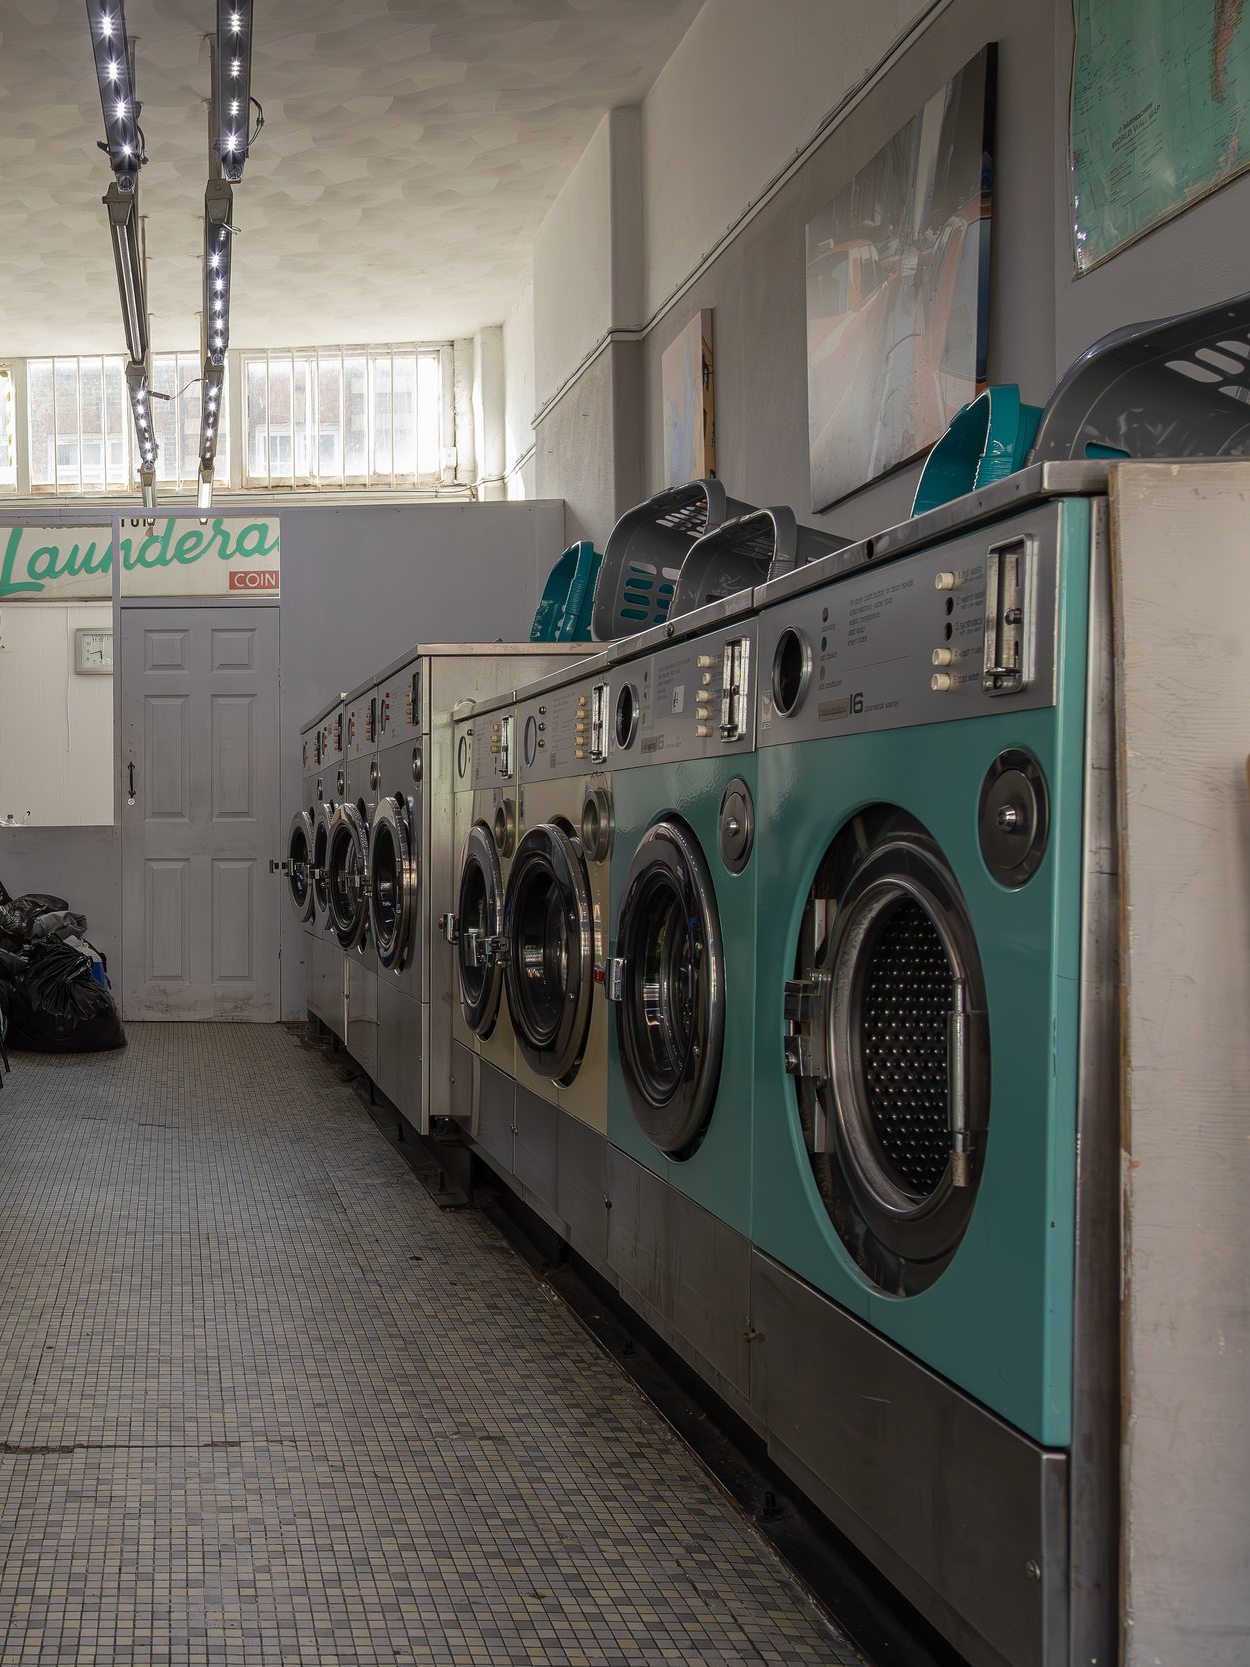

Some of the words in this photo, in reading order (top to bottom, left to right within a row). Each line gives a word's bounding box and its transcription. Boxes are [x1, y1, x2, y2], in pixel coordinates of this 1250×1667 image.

[1111, 128, 1132, 149] WORLD
[234, 573, 276, 588] COIN
[849, 692, 864, 715] 16
